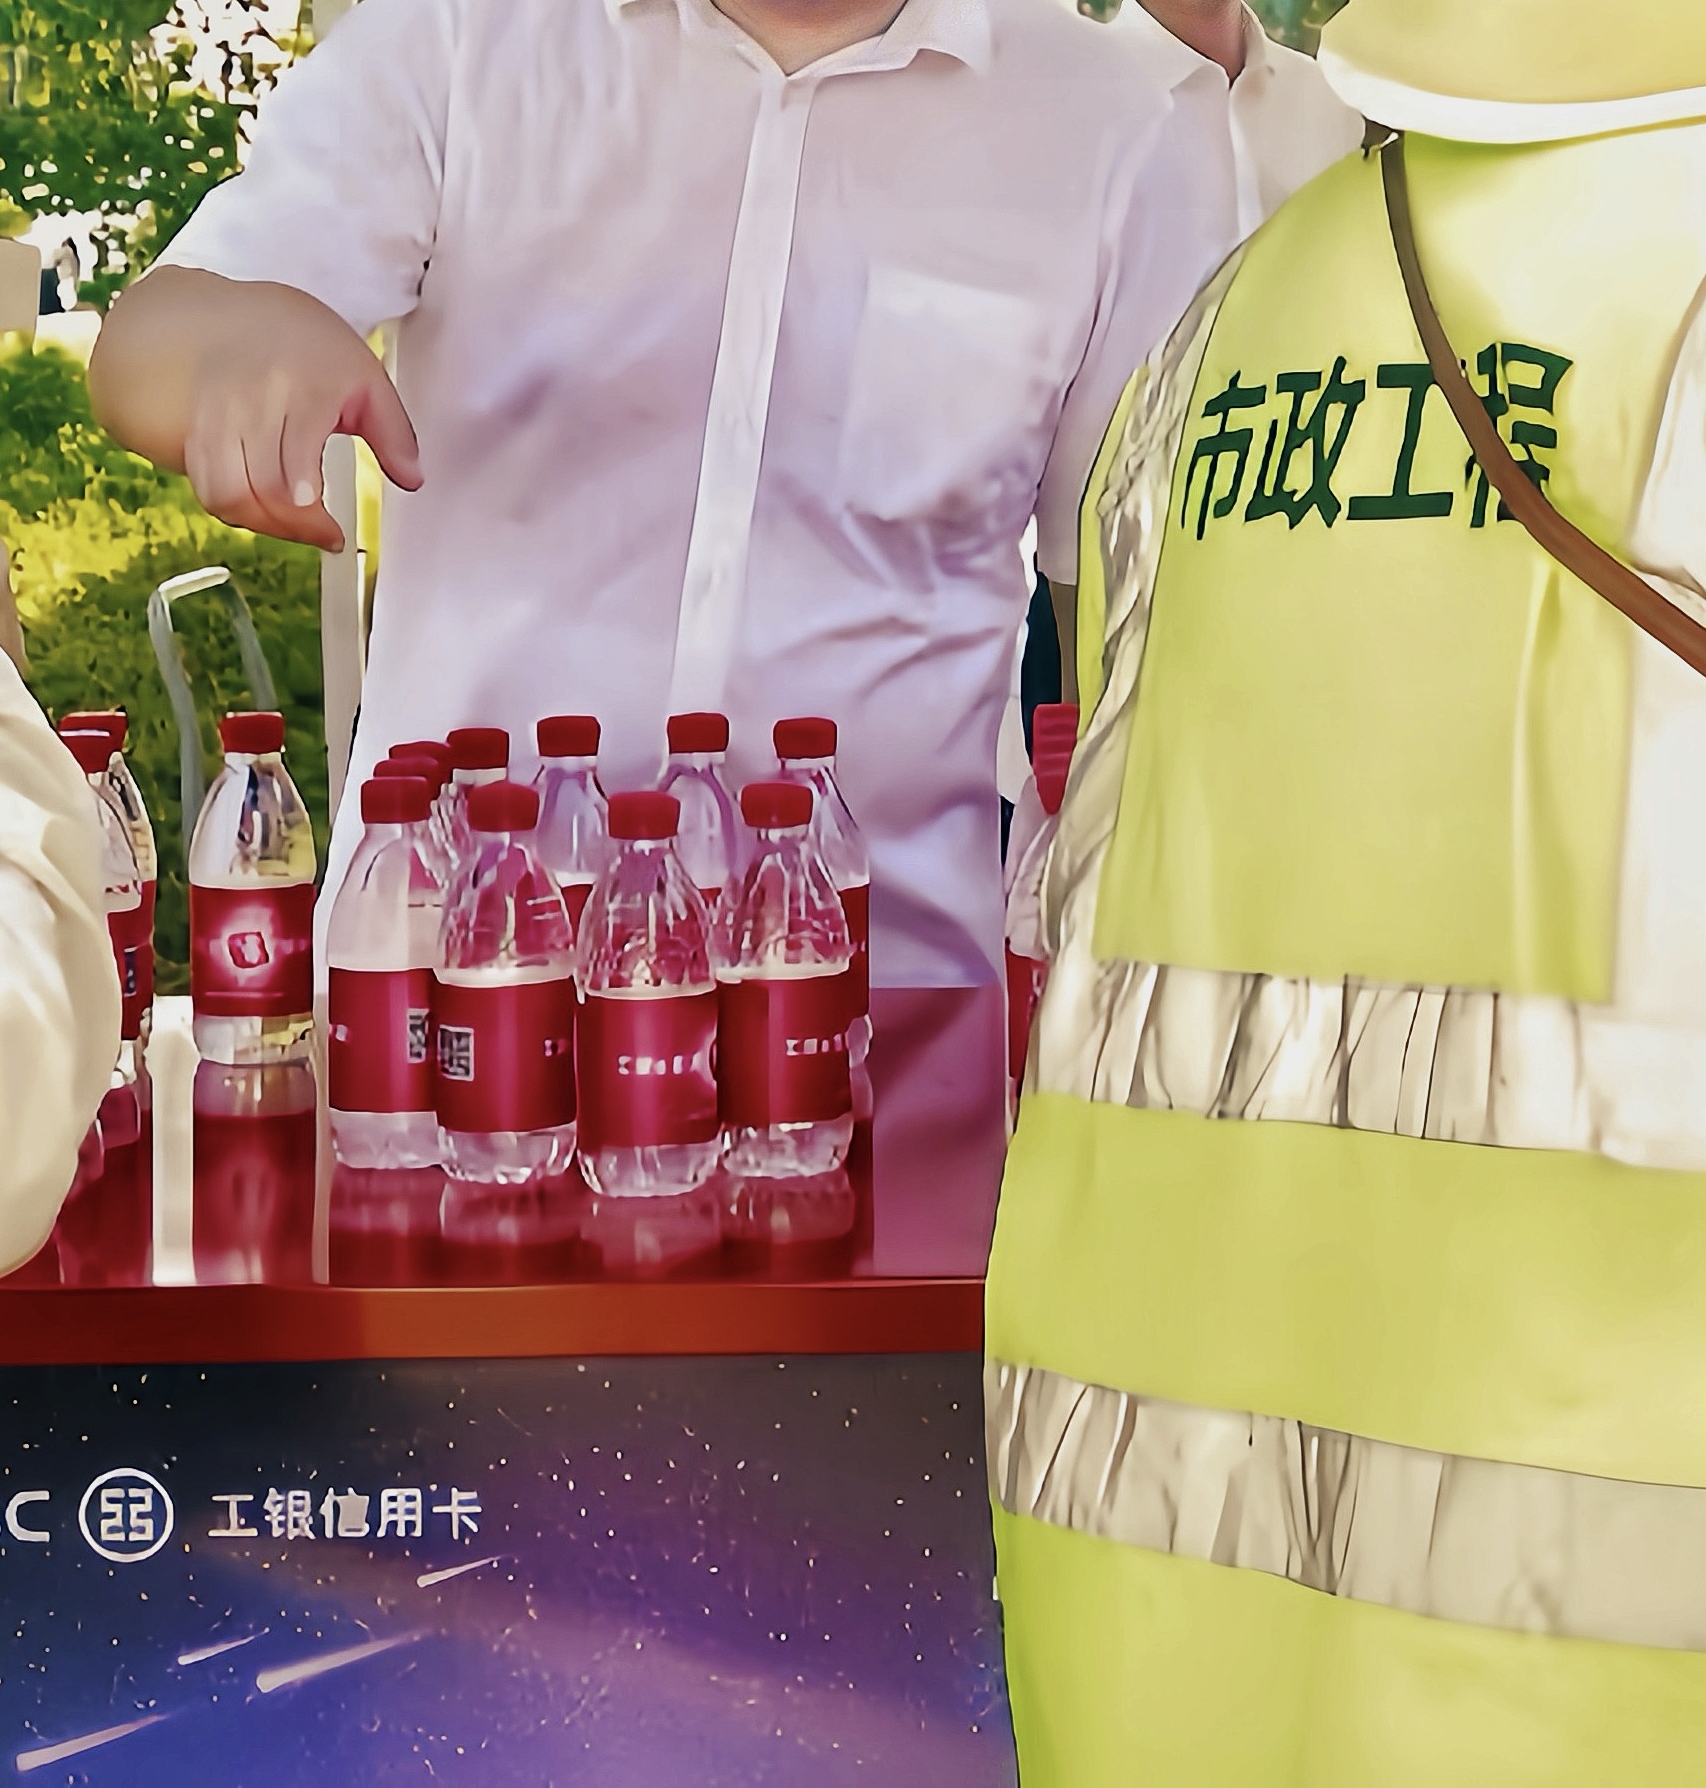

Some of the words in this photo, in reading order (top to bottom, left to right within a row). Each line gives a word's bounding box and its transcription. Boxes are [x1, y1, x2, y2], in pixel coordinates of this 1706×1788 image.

[208, 1487, 483, 1541] 工银信用卡
